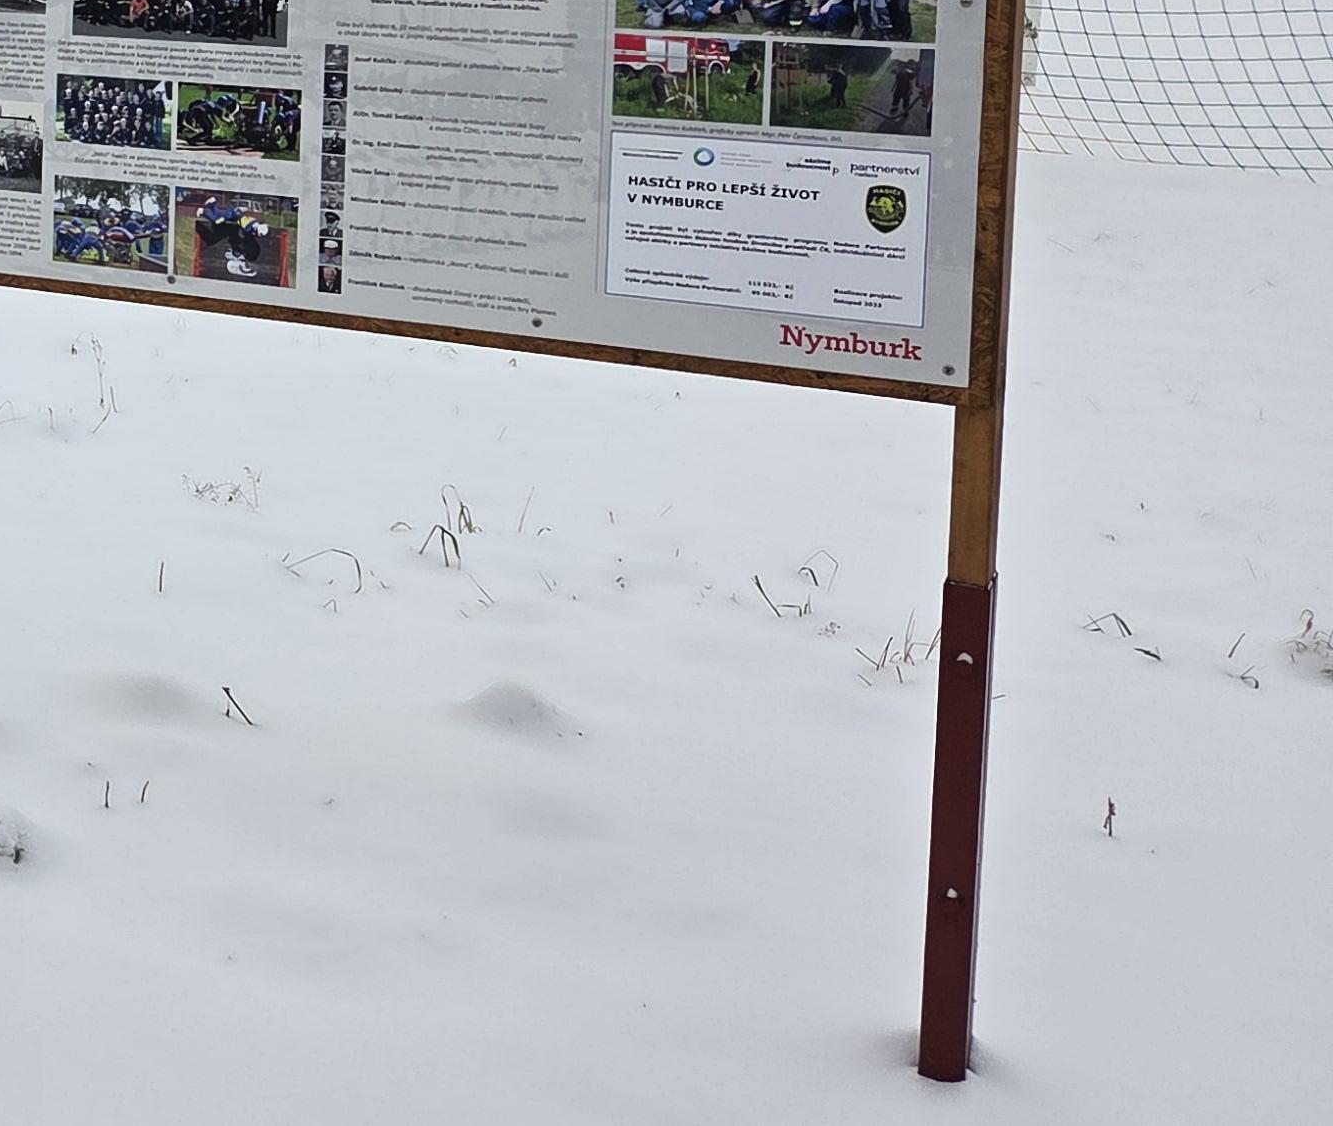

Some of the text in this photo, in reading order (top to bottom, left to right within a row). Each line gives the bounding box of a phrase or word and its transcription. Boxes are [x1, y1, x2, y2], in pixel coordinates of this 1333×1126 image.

[628, 176, 821, 201] HASIČI PRO LEPŠÍ ŽIVOT
[627, 193, 724, 211] V NYMBURCE
[780, 324, 922, 361] Nymburk
